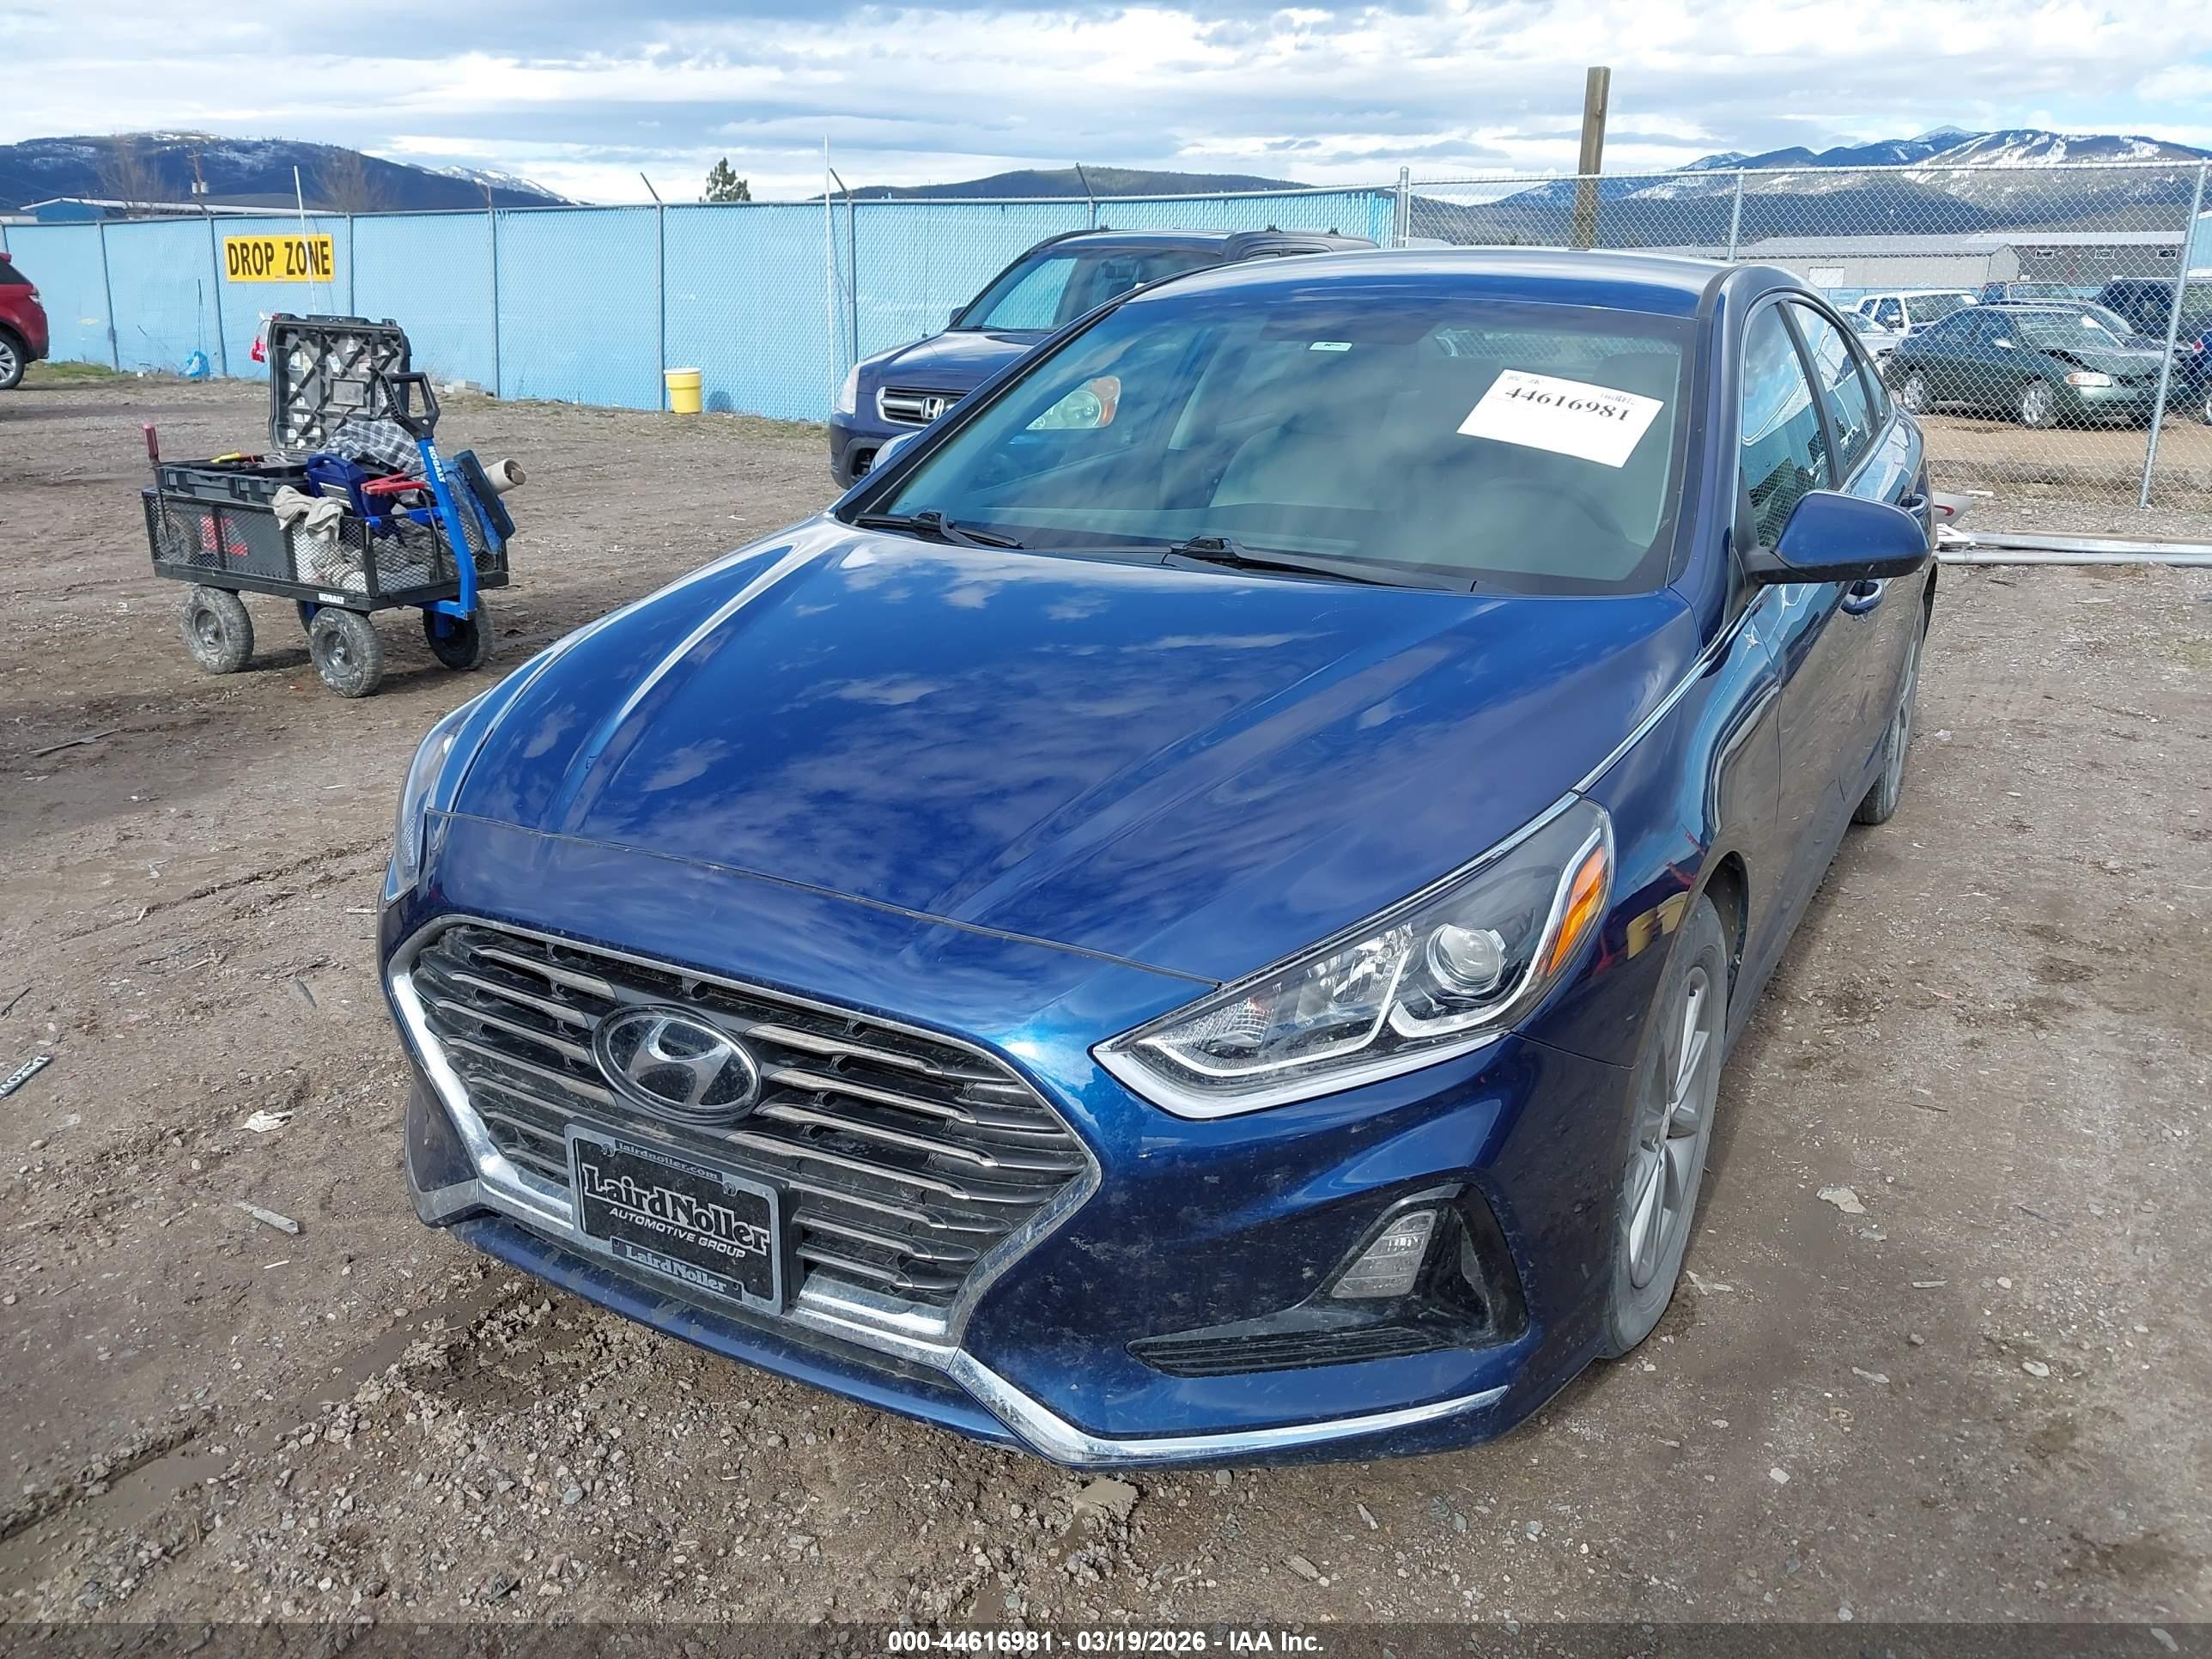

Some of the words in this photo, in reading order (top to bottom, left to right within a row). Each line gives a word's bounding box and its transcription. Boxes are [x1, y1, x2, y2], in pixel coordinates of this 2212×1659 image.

[227, 241, 275, 276] DROP
[284, 240, 331, 276] ZONE
[1504, 387, 1630, 421] 44616981
[427, 446, 447, 483] KOBALT
[583, 1164, 770, 1256] LairdNoller
[609, 1207, 696, 1243] AUTOMOTIVE
[698, 1234, 746, 1259] GROUP
[625, 1244, 727, 1293] LairdNoller
